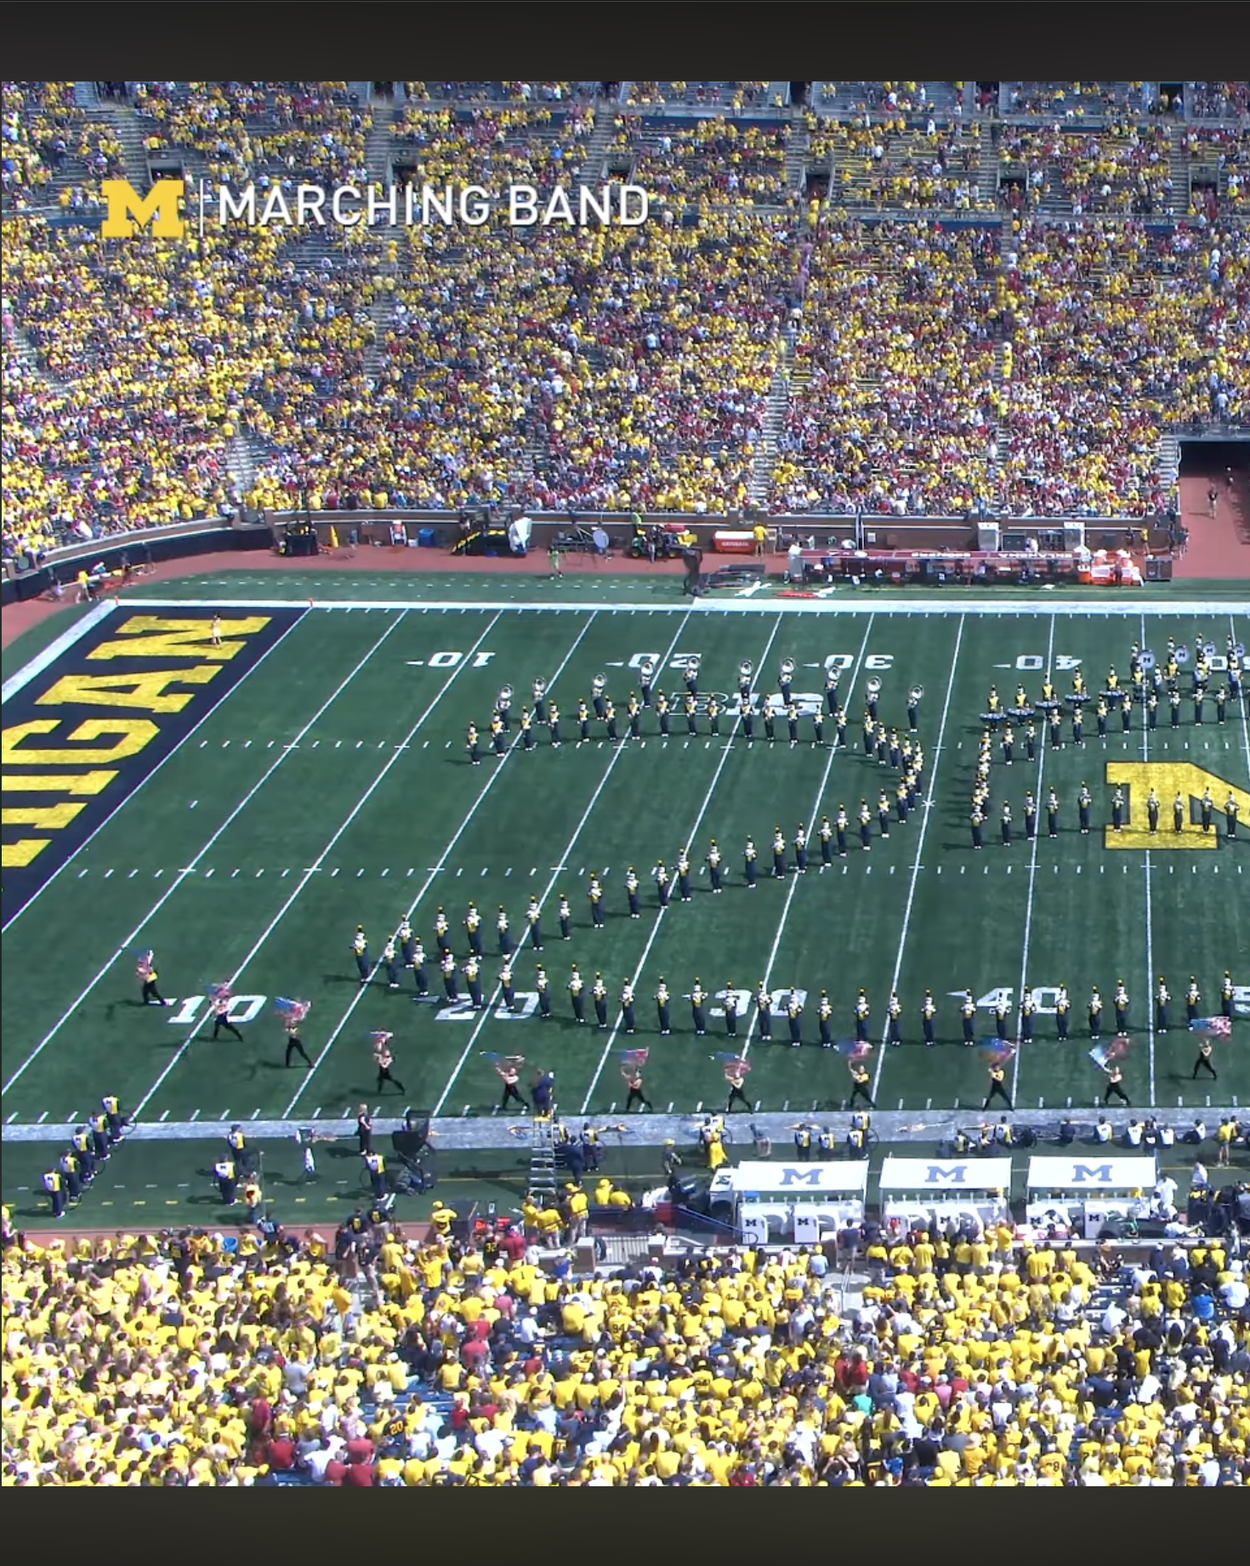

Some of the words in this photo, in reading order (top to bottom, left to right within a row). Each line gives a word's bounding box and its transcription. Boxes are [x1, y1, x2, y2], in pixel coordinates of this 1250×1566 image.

[428, 652, 496, 667] 10
[167, 995, 267, 1023] 10
[434, 993, 539, 1021] 20
[709, 989, 808, 1017] 30
[976, 987, 1068, 1015] 40
[779, 1168, 823, 1185] M
[925, 1165, 968, 1183] M
[1071, 1164, 1113, 1182] M
[744, 1219, 757, 1227] M
[797, 1217, 809, 1226] M
[1088, 1214, 1100, 1222] M
[389, 1422, 404, 1435] 20
